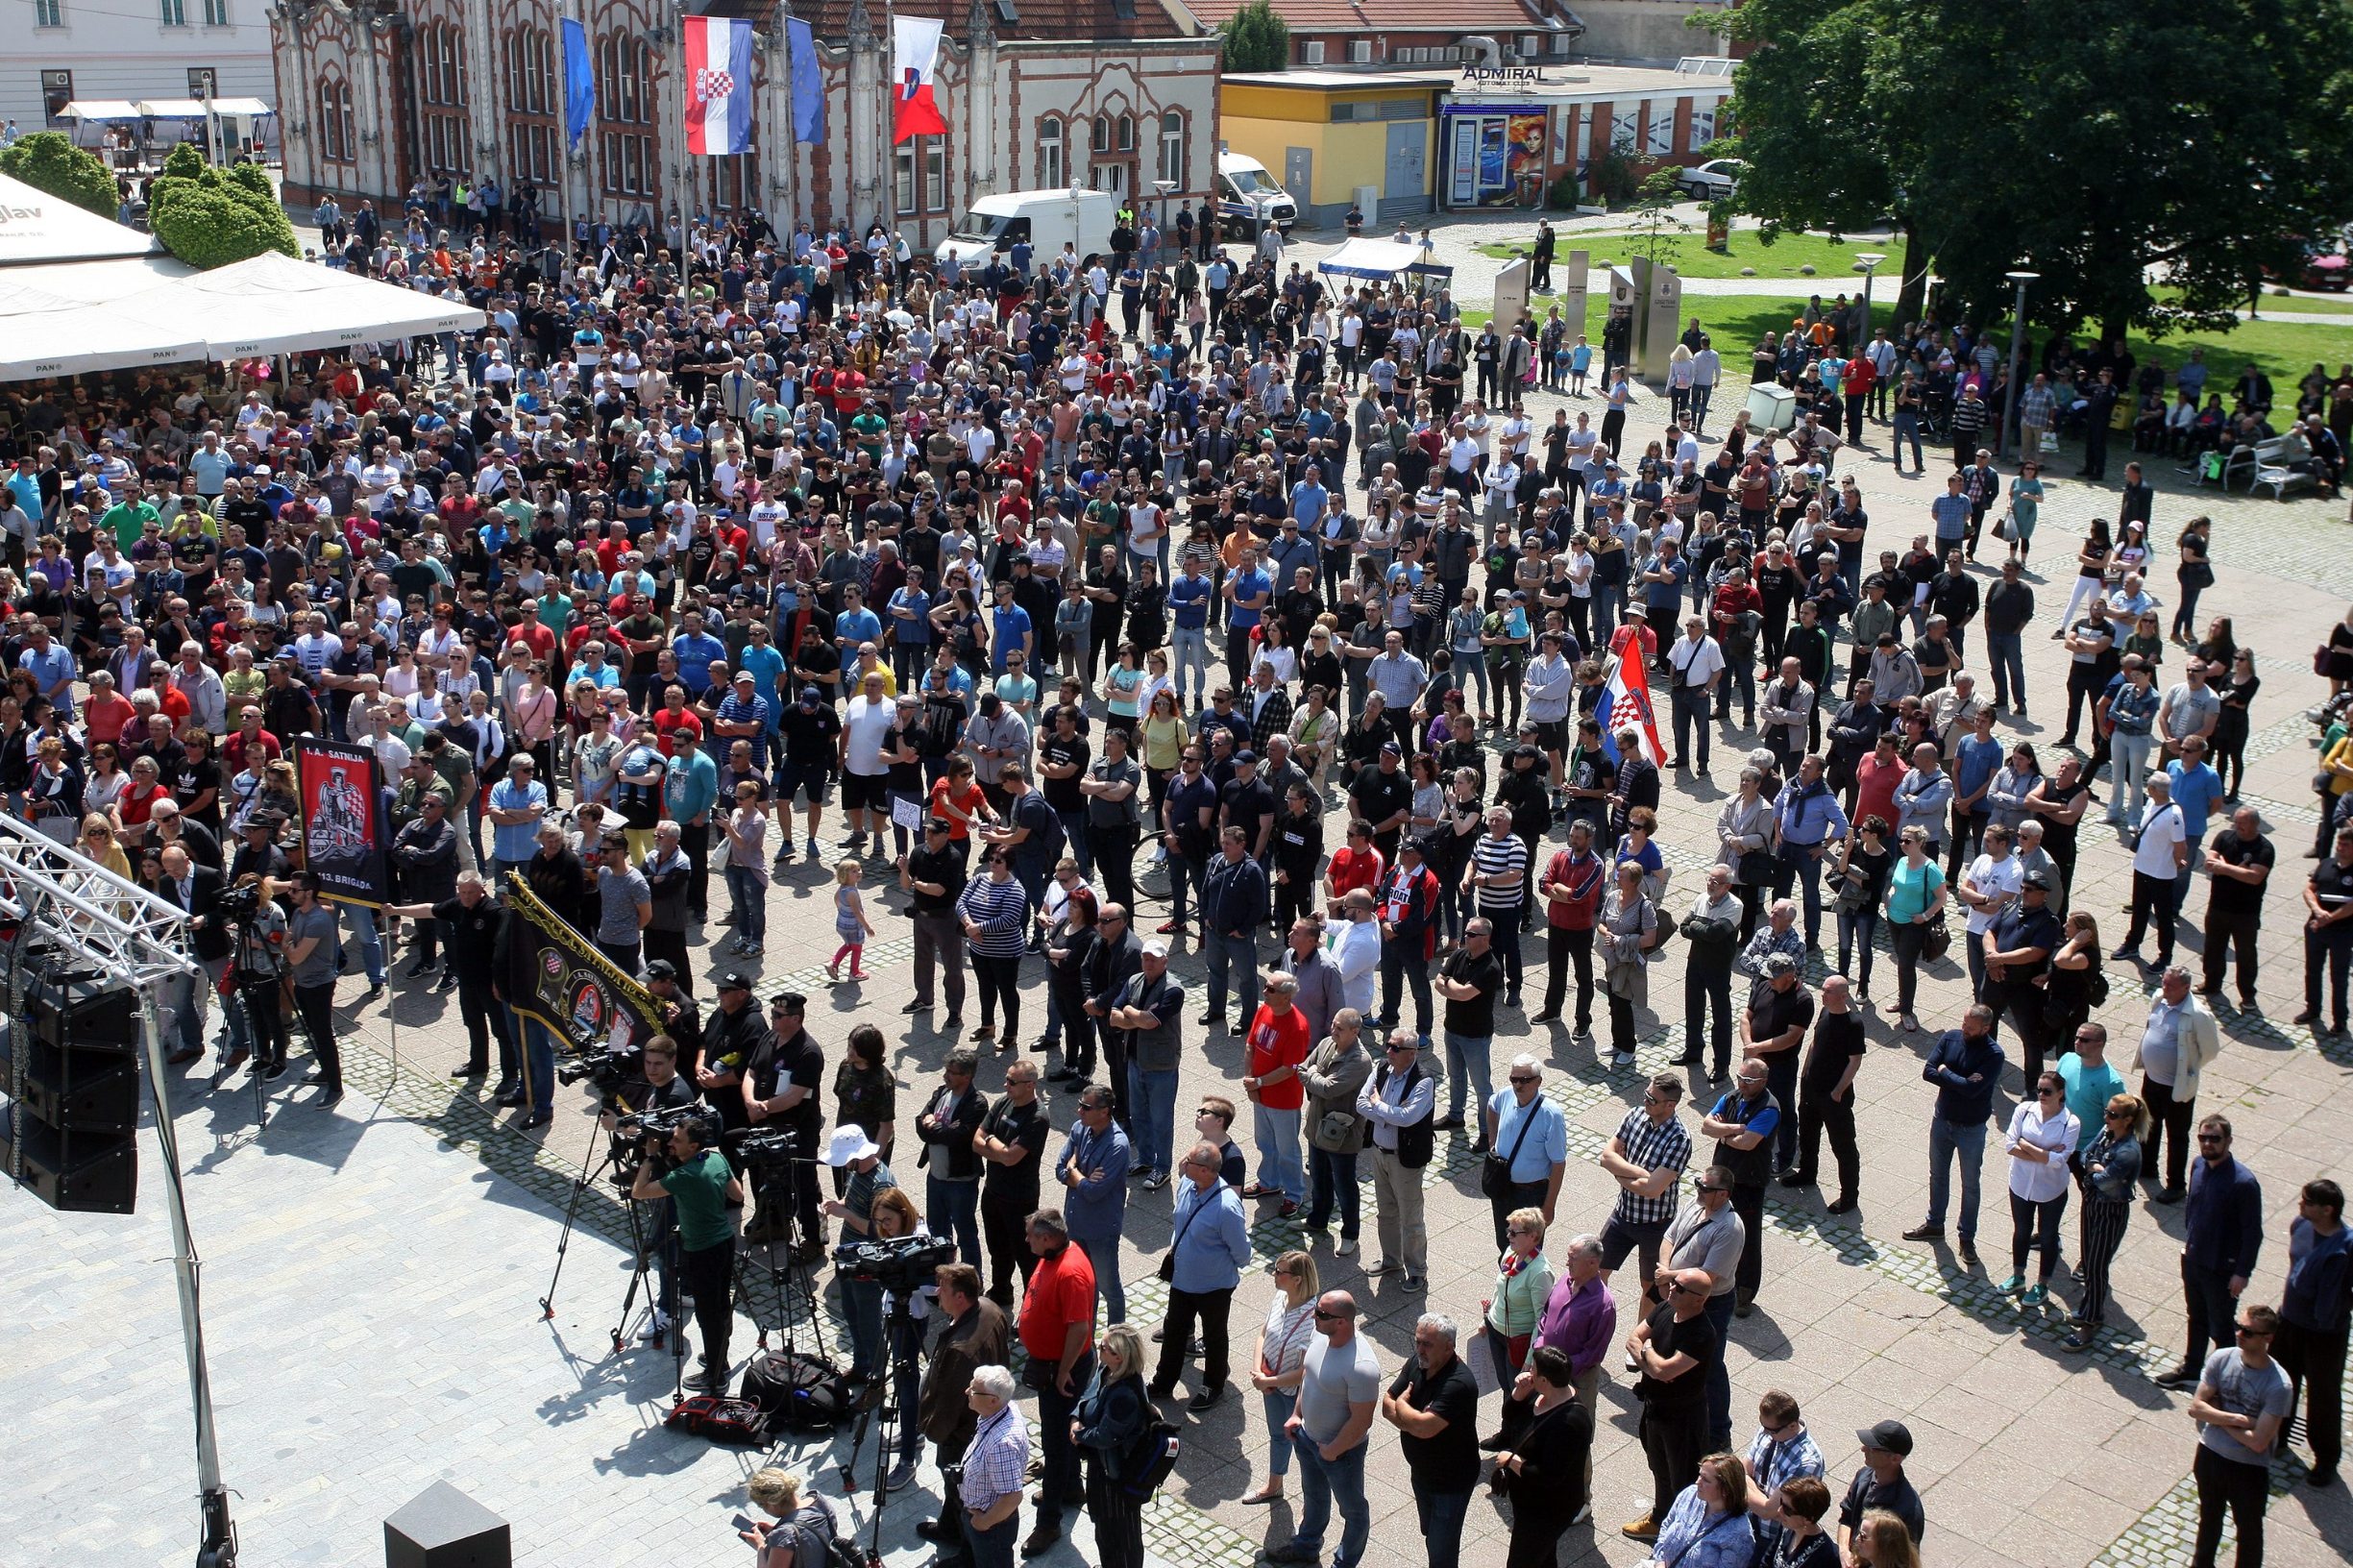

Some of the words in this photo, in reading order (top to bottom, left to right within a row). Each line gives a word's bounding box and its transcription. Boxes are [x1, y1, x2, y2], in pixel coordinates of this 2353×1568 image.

[1462, 66, 1548, 81] ADMIRAL
[438, 319, 453, 328] PAN
[234, 345, 253, 354] PAN
[36, 364, 55, 373] PAN
[306, 747, 313, 756] 1.
[315, 748, 324, 757] A.
[328, 749, 364, 763] SATNIJA
[334, 874, 374, 891] BRIGADA
[578, 946, 623, 990] SATNIJA
